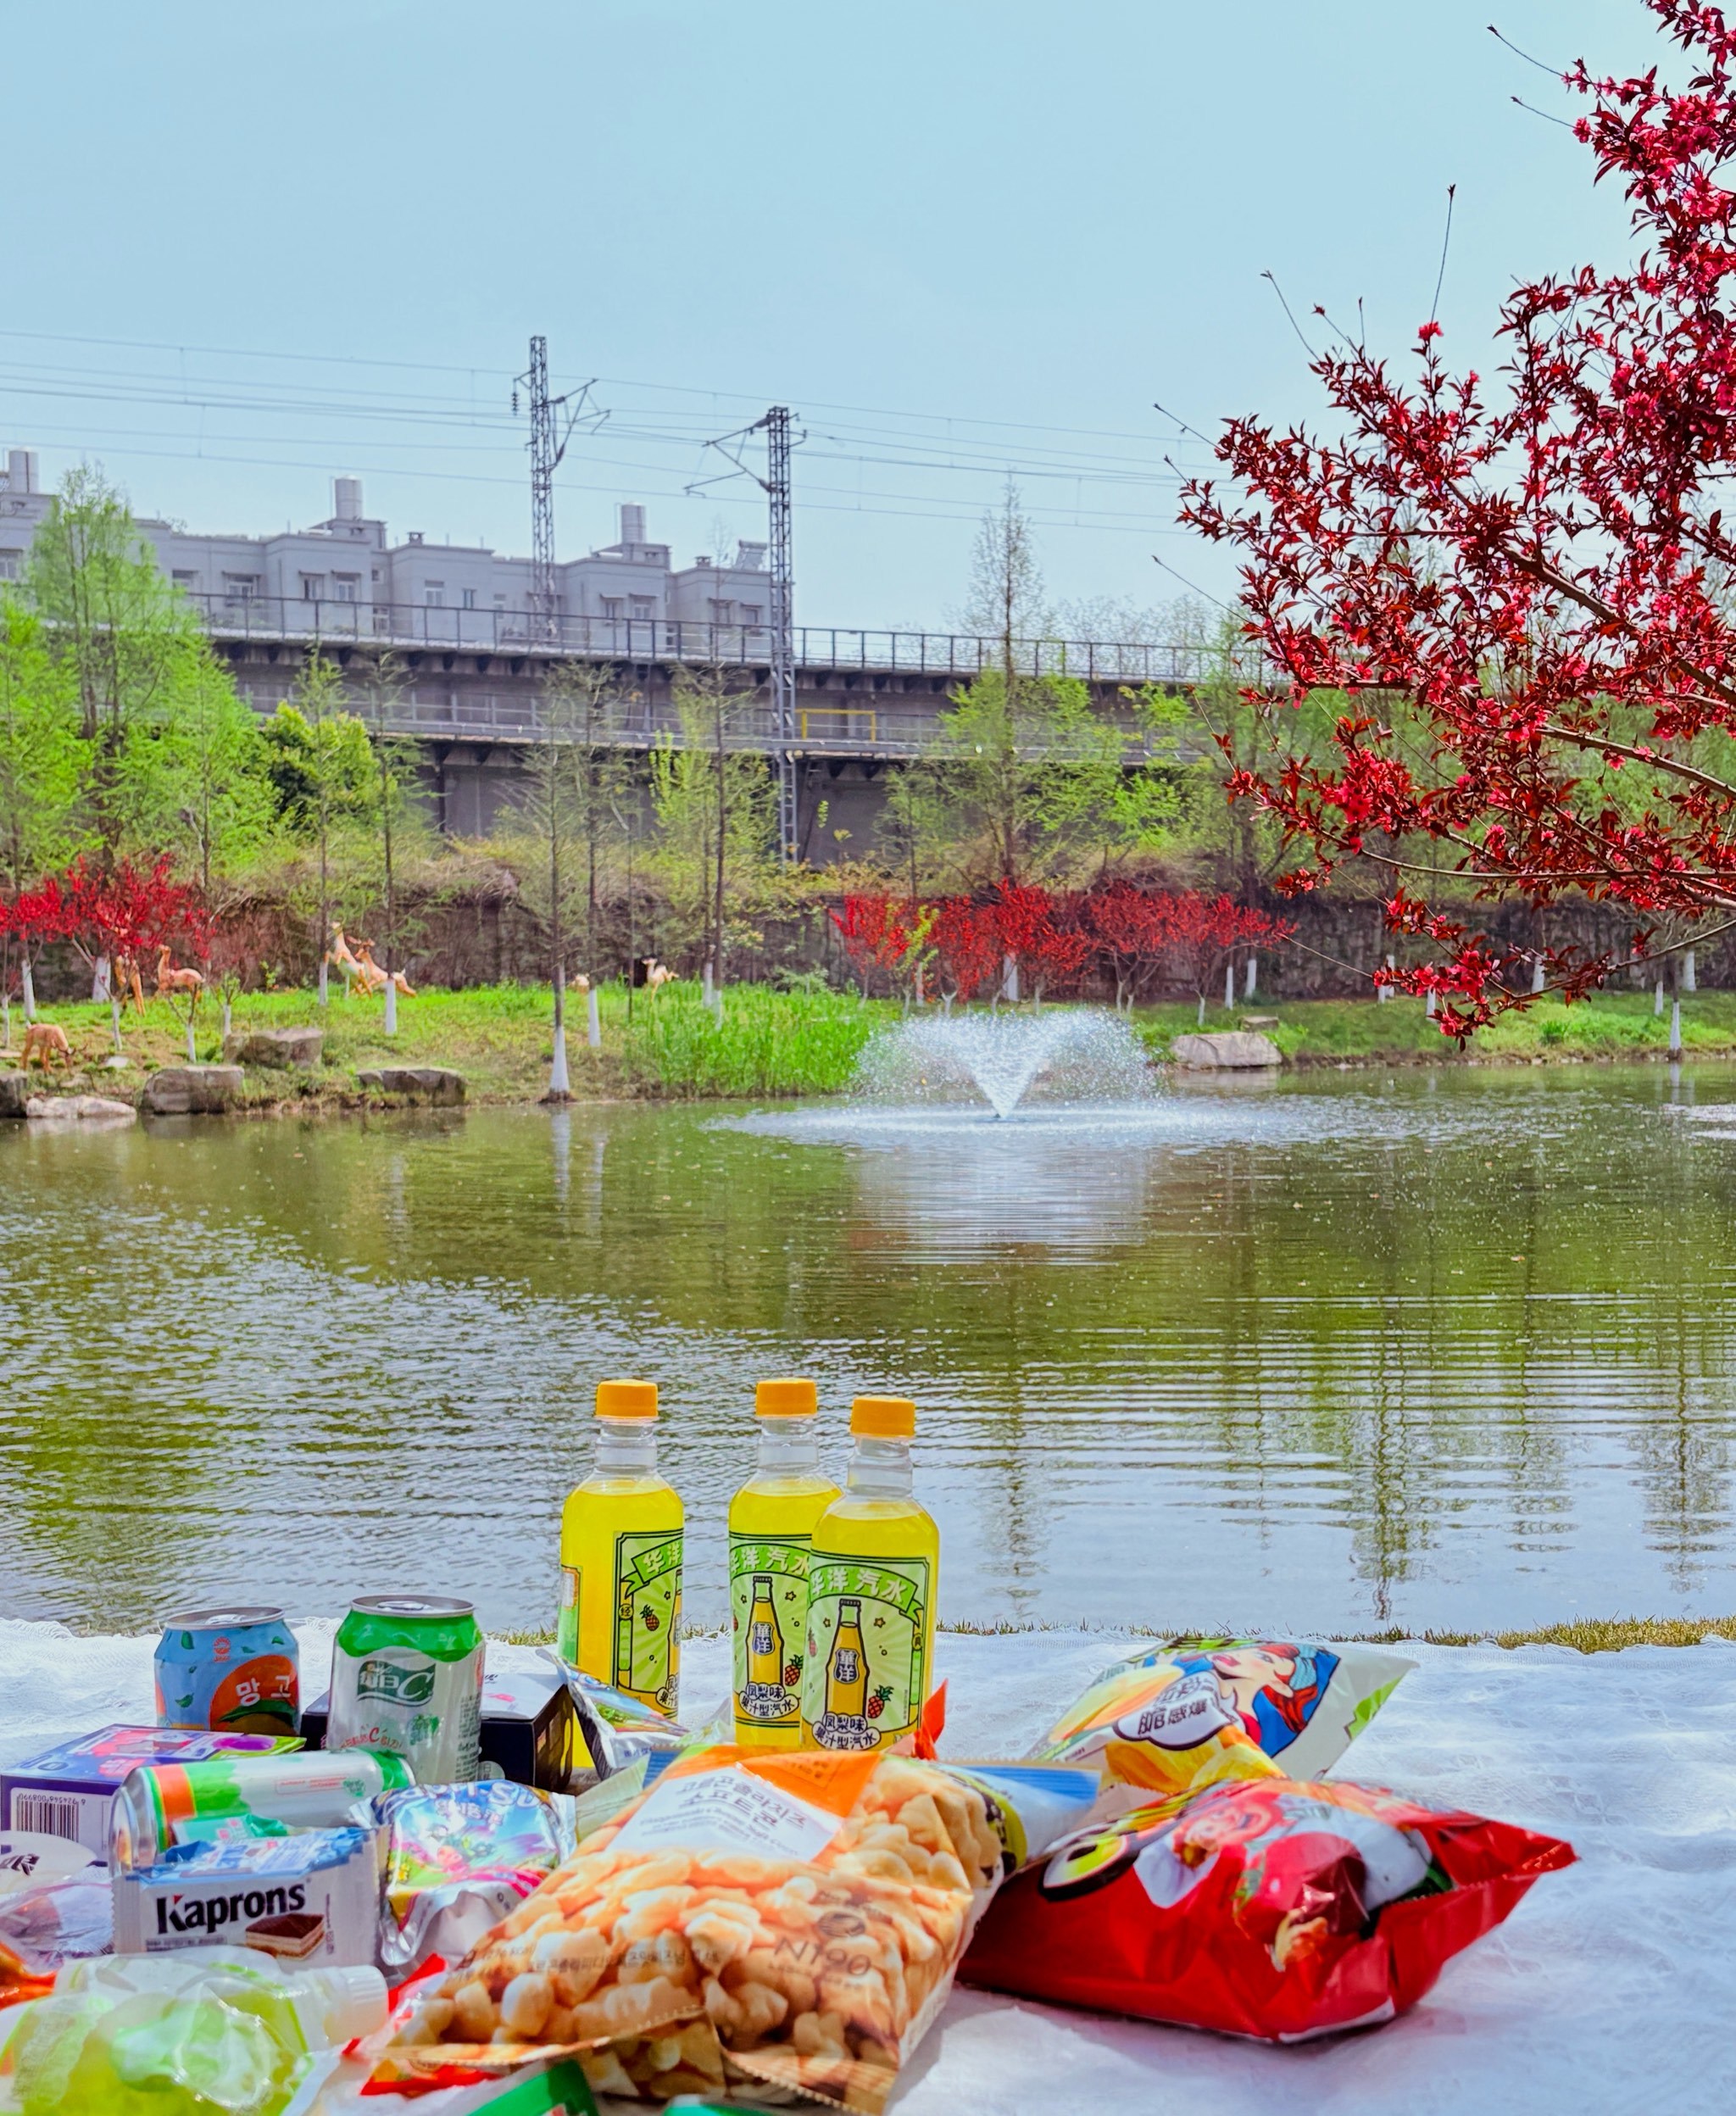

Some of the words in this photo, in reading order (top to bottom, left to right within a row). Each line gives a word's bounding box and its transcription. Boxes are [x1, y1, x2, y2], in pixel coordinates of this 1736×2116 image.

[812, 1567, 908, 1605] 华洋汽水
[236, 1674, 292, 1707] 망고
[747, 1684, 782, 1699] 凤梨味
[741, 1695, 795, 1717] 果汁型汽水
[825, 1714, 865, 1731] 凤梨味
[815, 1726, 876, 1751] 果汁型汽水
[156, 1883, 305, 1935] Kaprons
